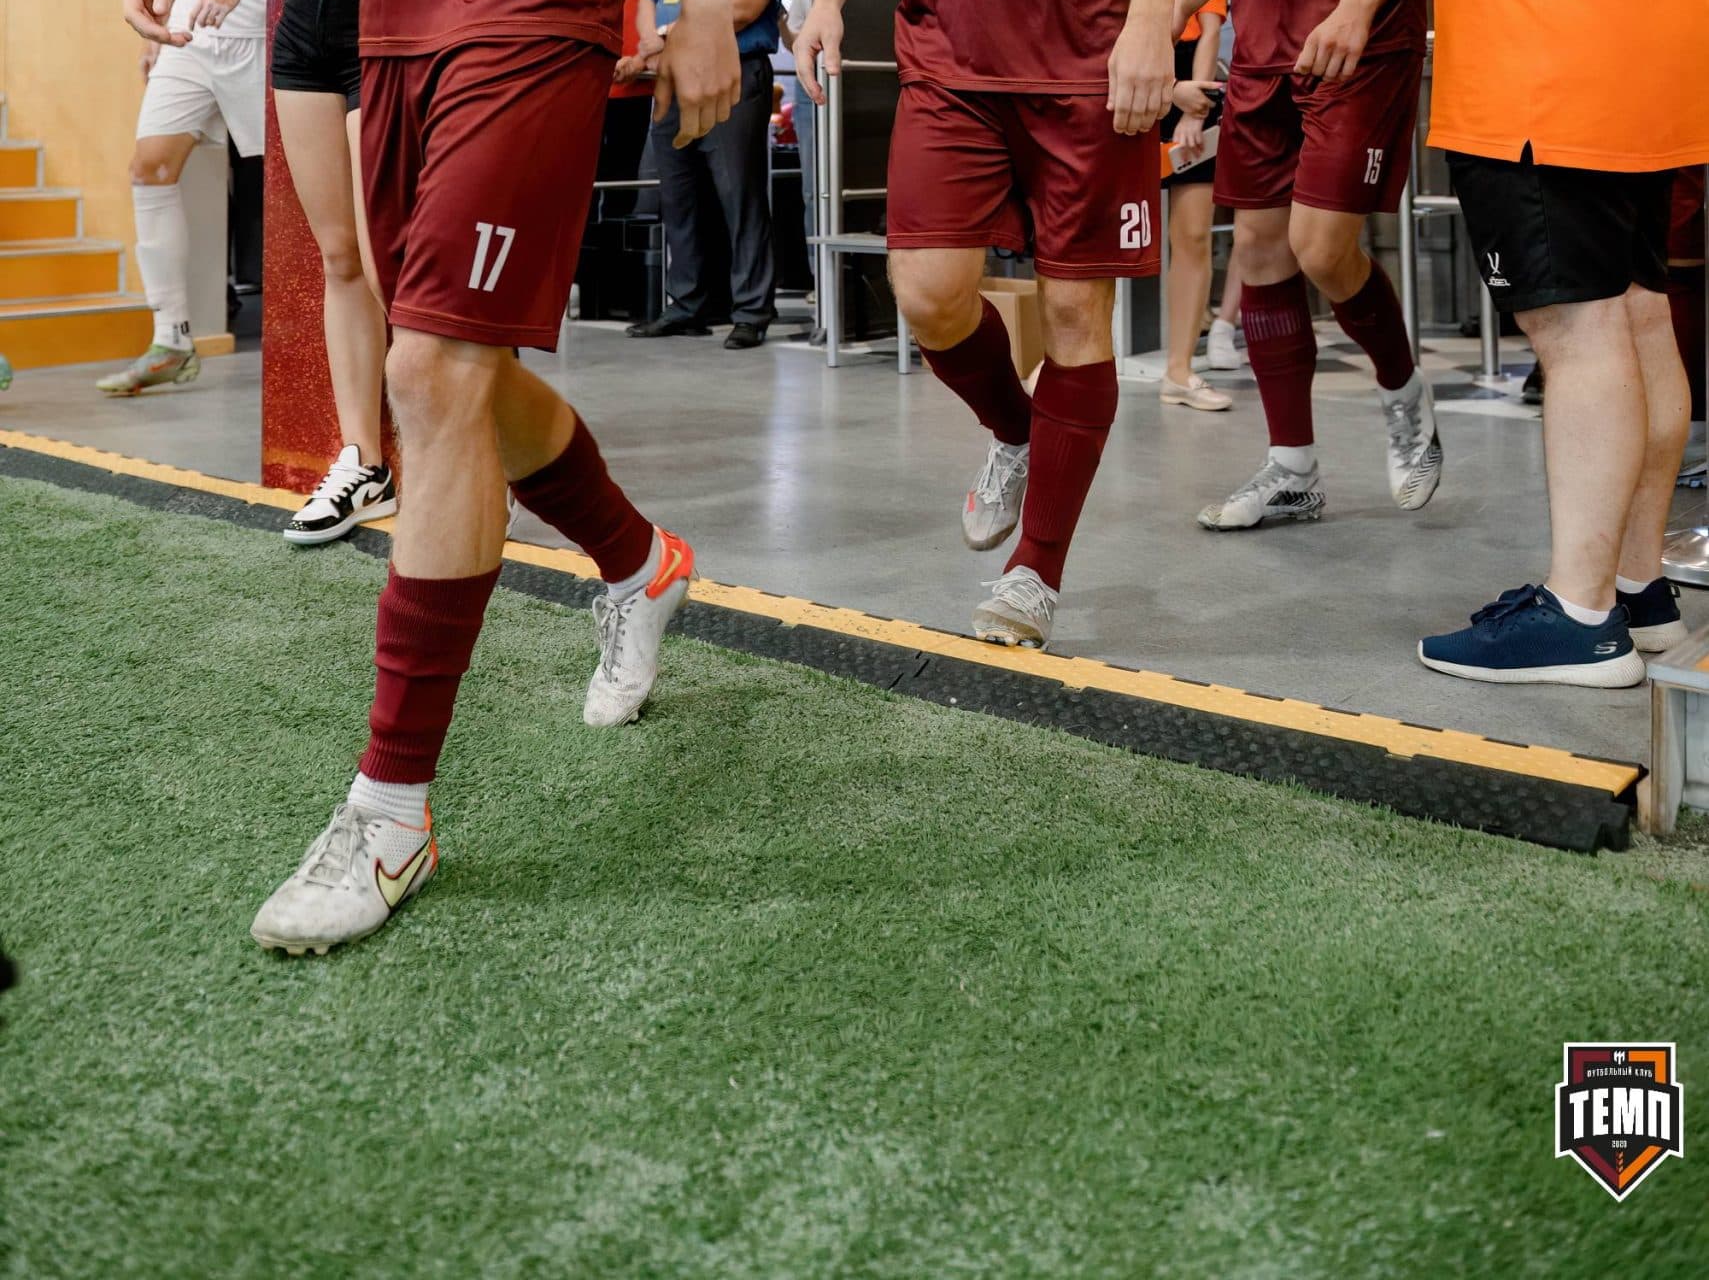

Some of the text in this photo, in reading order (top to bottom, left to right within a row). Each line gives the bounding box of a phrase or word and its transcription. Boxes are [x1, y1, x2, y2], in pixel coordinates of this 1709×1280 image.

[1363, 148, 1384, 184] 15
[1119, 199, 1152, 249] 20
[468, 221, 516, 292] 17
